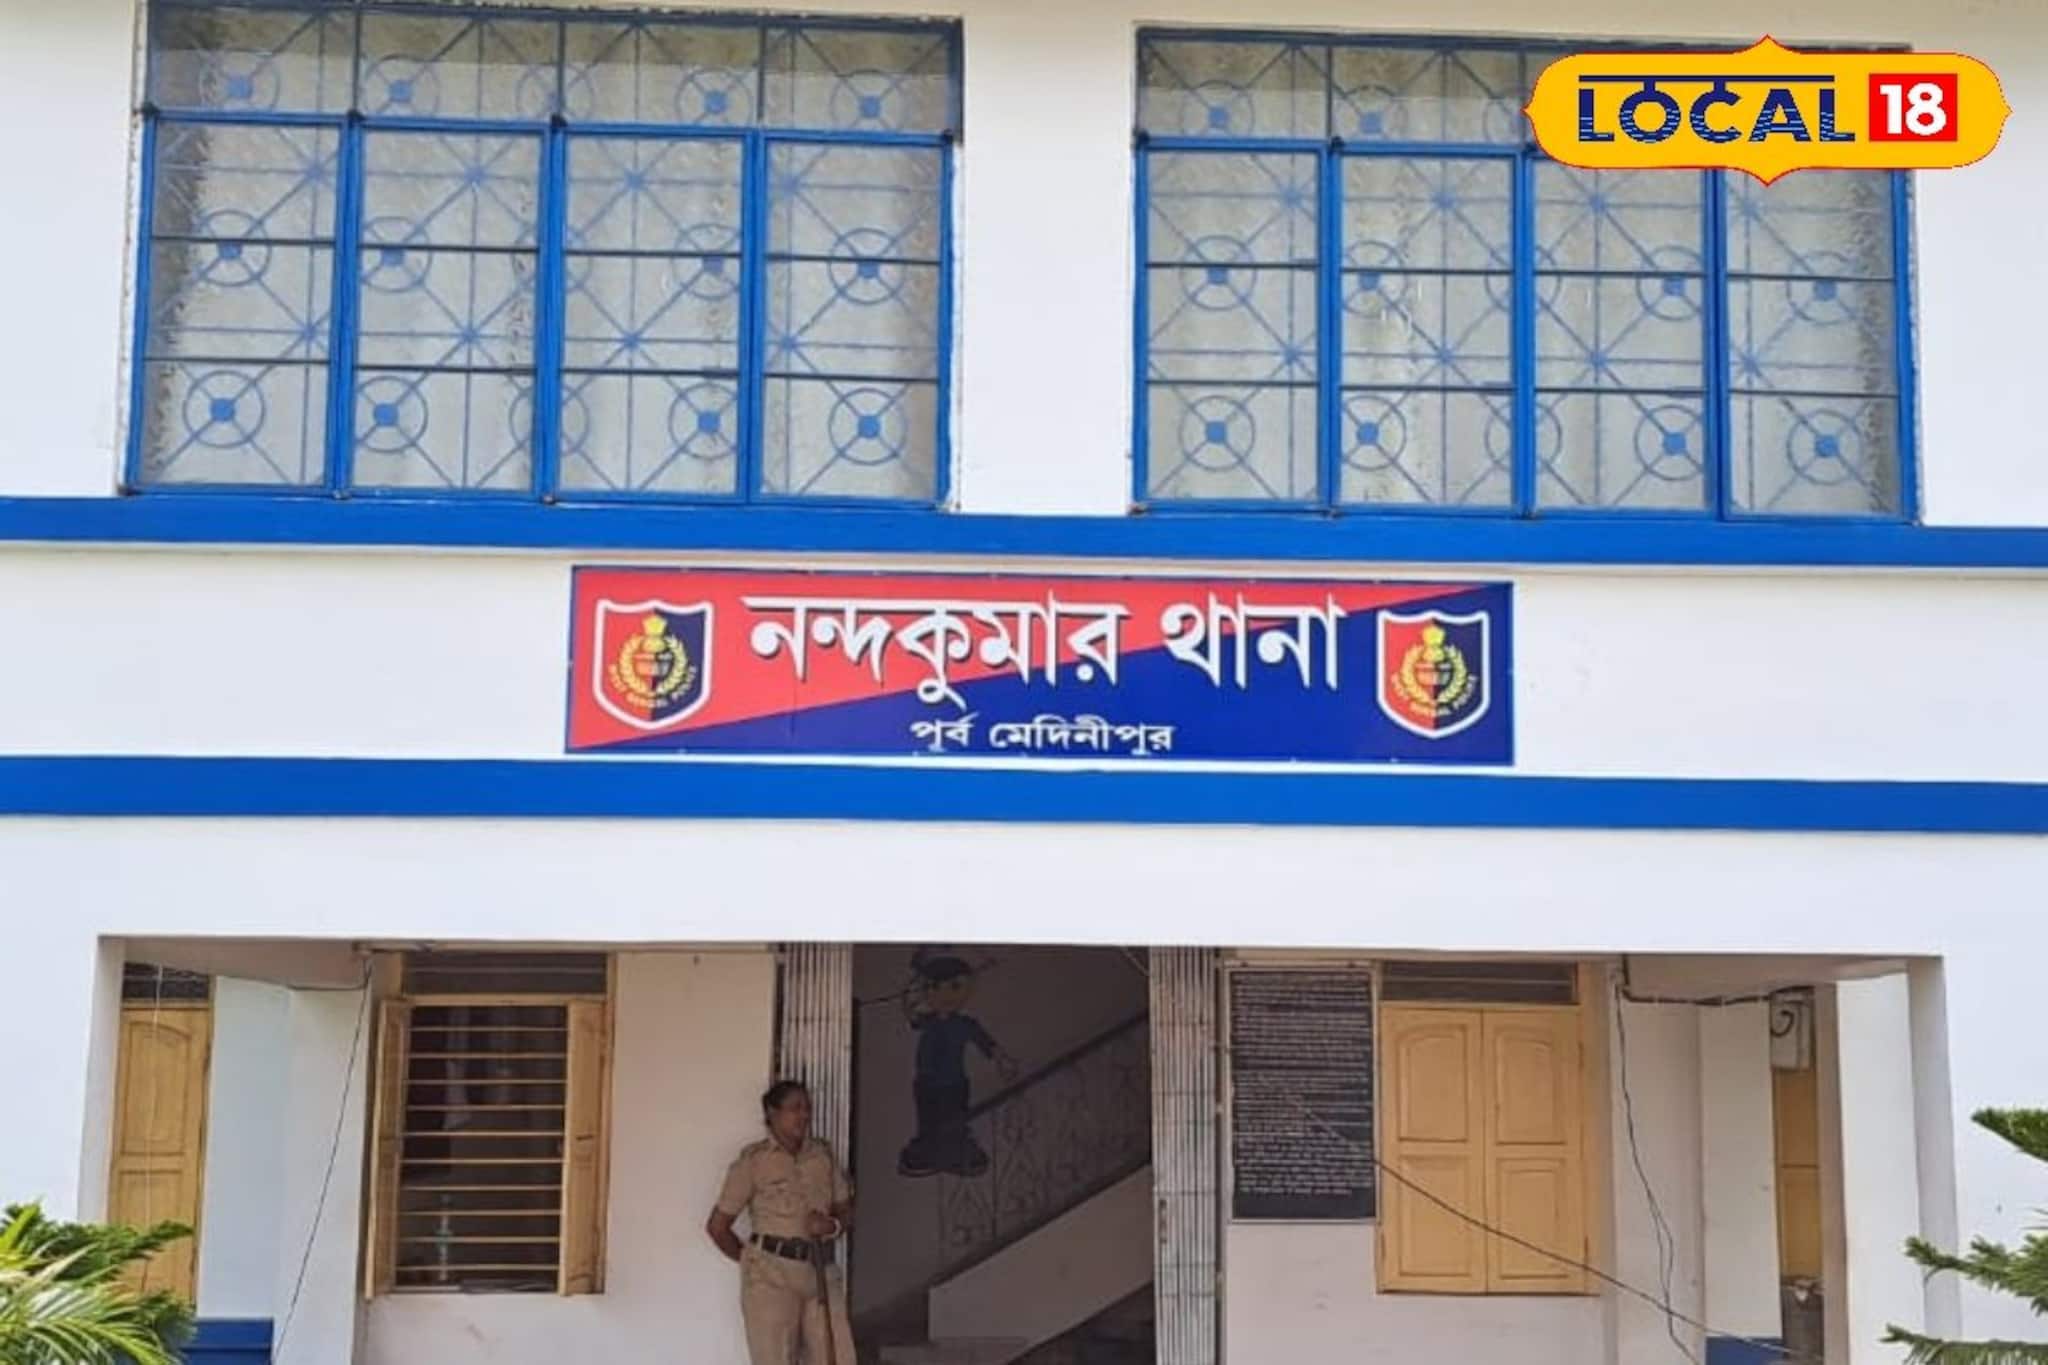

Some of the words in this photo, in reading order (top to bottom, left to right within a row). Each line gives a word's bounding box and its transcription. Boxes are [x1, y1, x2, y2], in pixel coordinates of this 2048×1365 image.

[741, 591, 1131, 711] নন্দকুমার
[1160, 592, 1347, 690] থানা
[989, 714, 1176, 756] মেদিনীপুর
